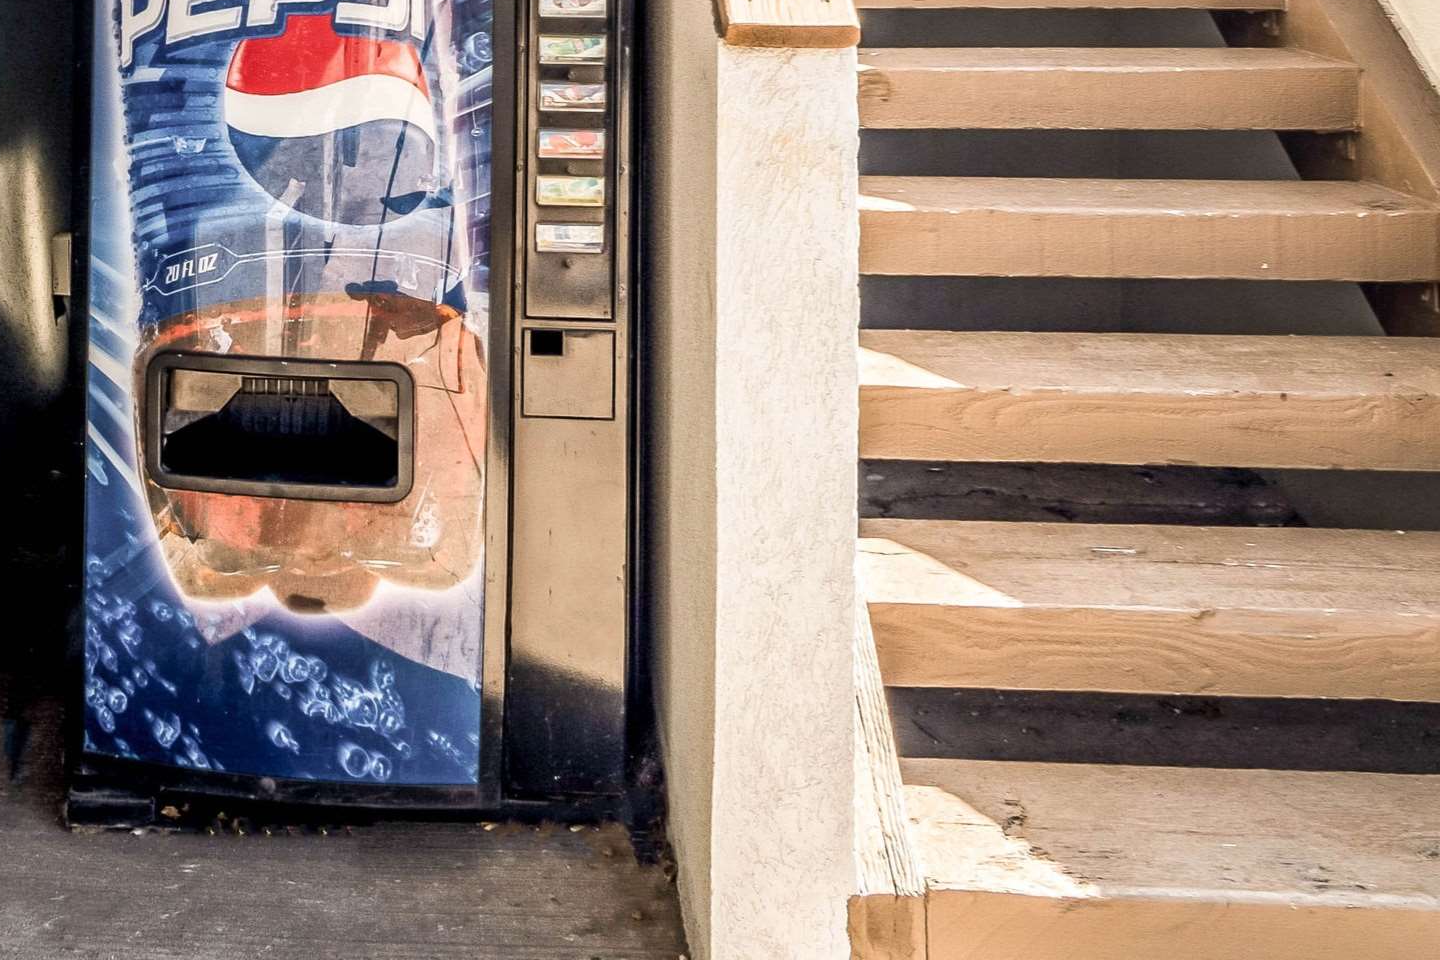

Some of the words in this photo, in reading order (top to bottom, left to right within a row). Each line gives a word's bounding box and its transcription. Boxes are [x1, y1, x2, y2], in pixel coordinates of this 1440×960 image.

[165, 263, 180, 285] 20
[181, 259, 196, 279] FL
[197, 252, 219, 274] OZ
